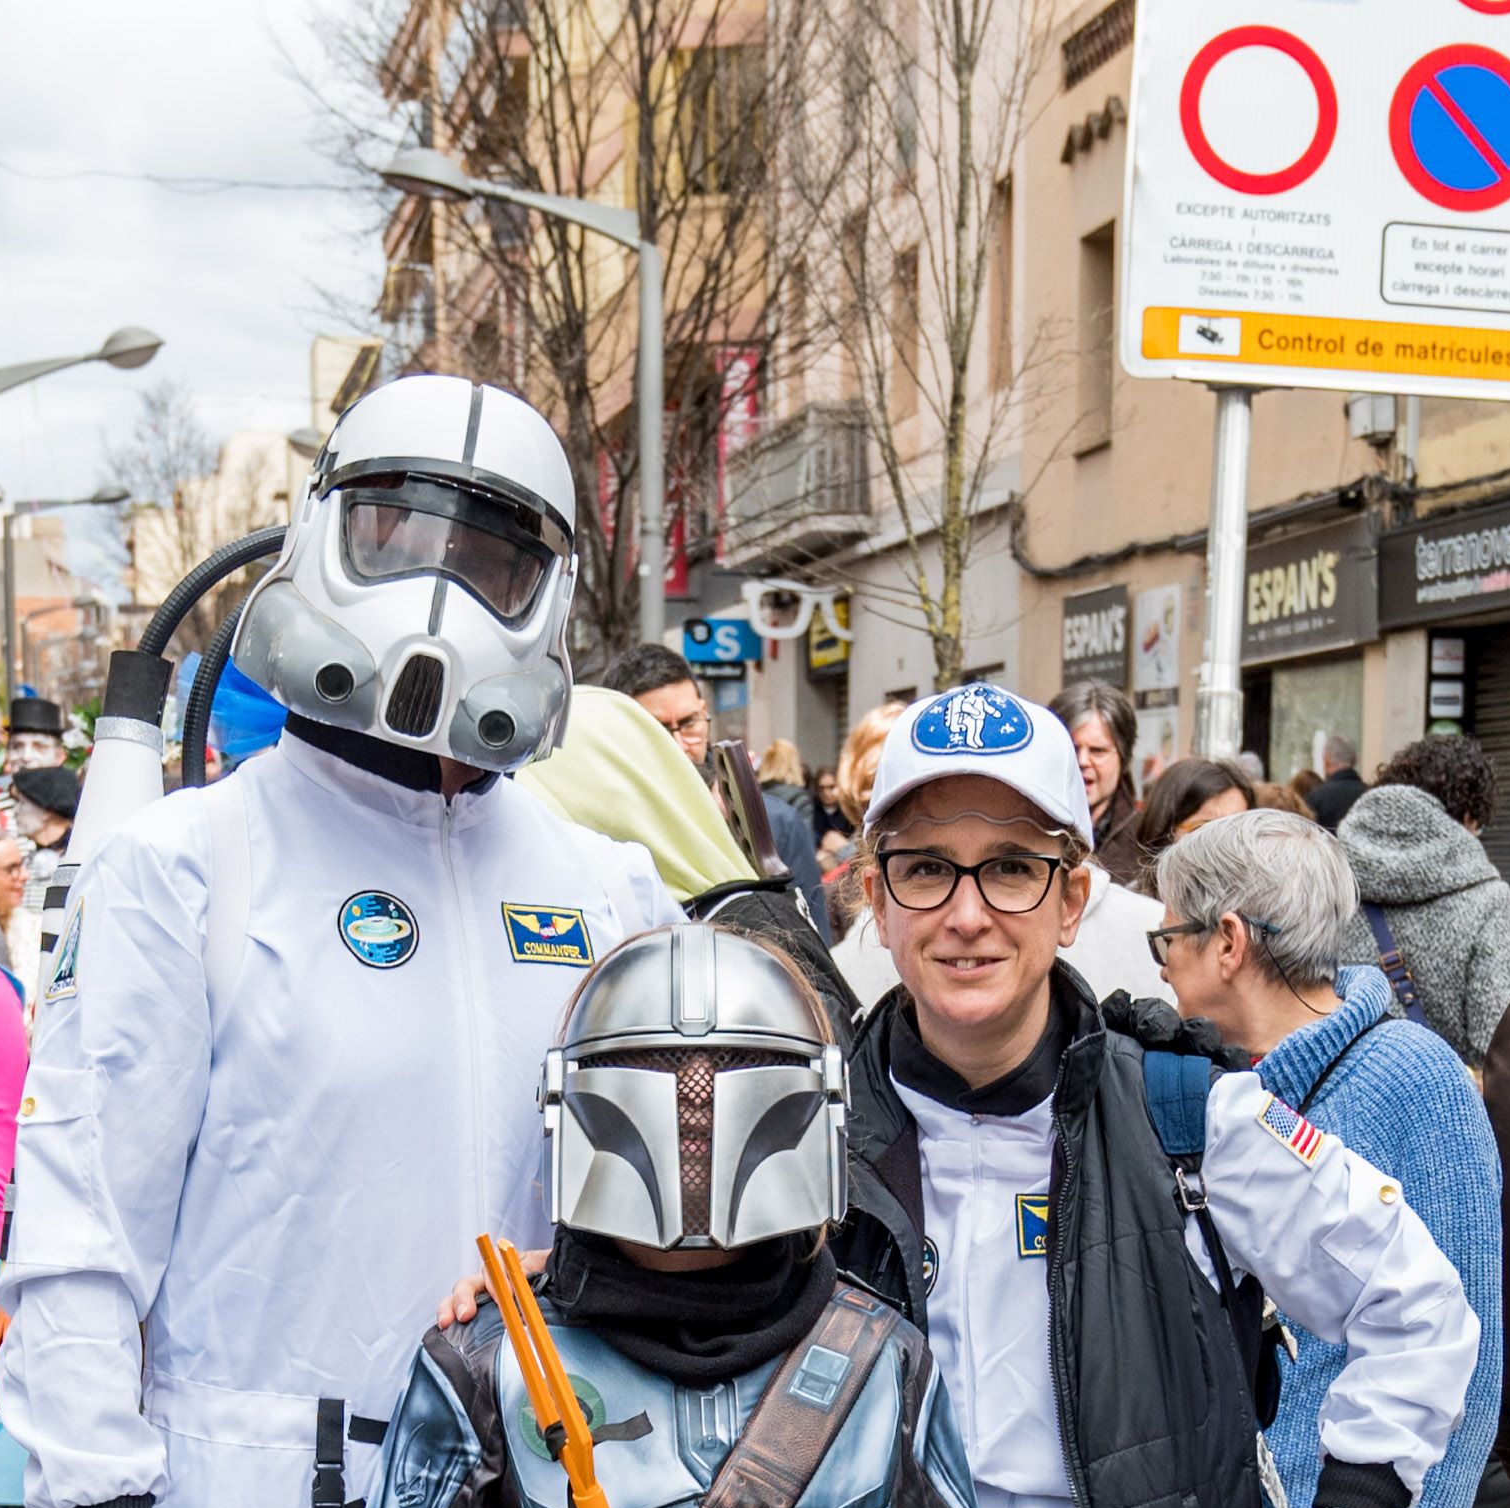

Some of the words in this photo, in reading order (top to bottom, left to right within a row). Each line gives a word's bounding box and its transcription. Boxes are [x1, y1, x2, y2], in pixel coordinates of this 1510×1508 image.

[1176, 202, 1235, 219] EXCEPTE
[1242, 207, 1331, 227] AUTORITZATS
[1412, 237, 1428, 250] En
[1433, 240, 1450, 252] tot
[1455, 242, 1466, 252] el
[1471, 245, 1508, 257] carrer
[1414, 261, 1464, 276] excepte
[1257, 328, 1345, 354] Control
[1355, 338, 1383, 357] de
[524, 942, 582, 959] COMMANDER
